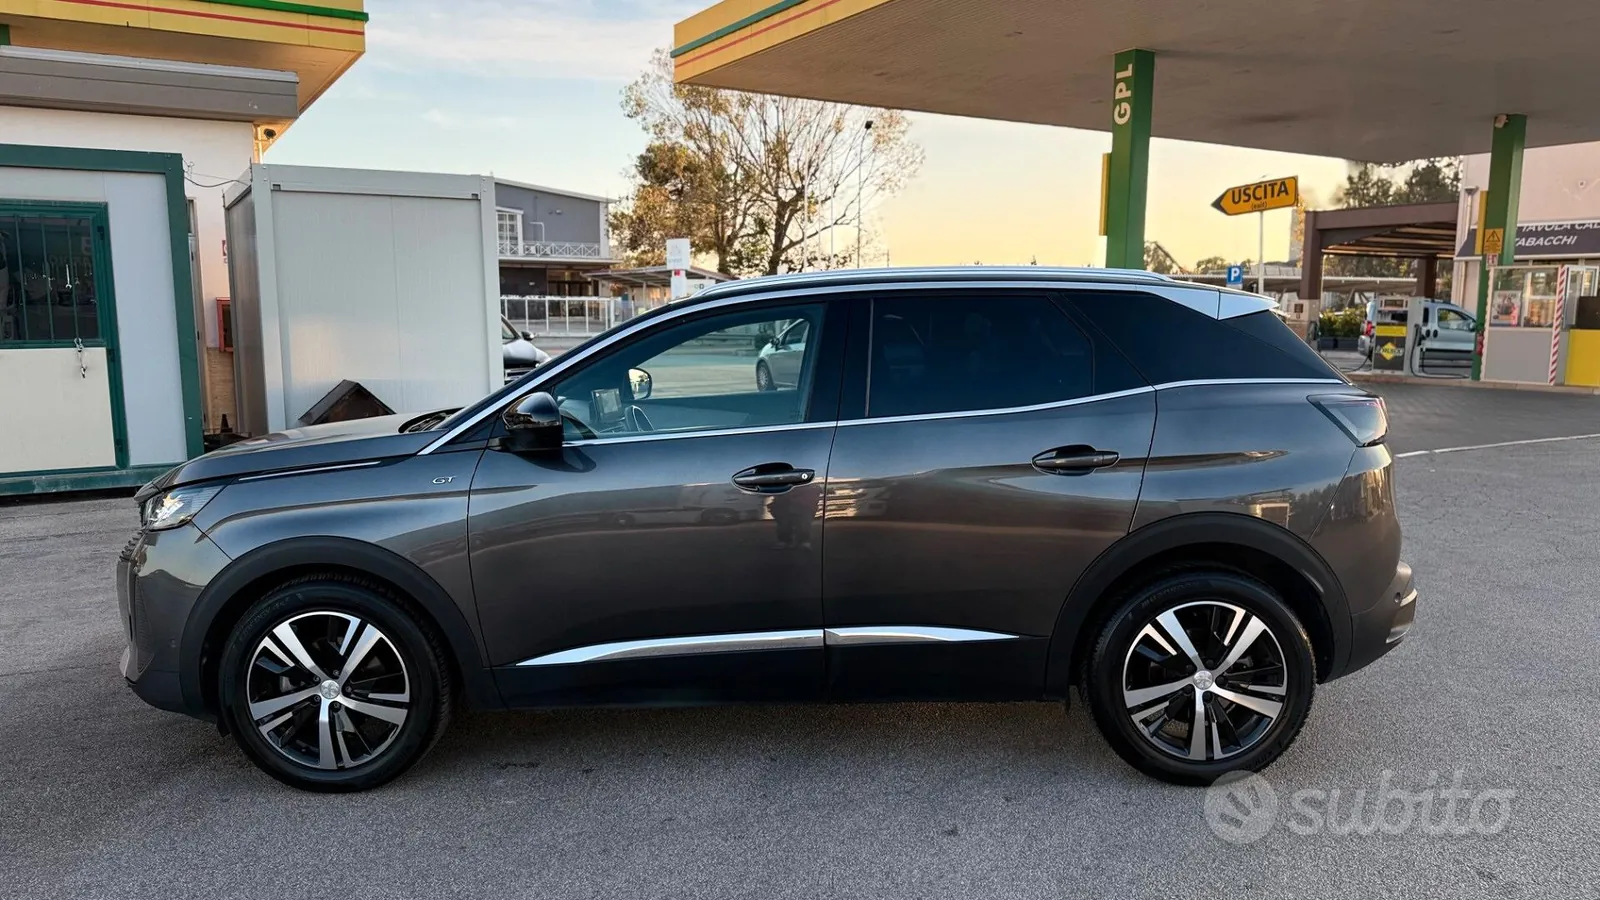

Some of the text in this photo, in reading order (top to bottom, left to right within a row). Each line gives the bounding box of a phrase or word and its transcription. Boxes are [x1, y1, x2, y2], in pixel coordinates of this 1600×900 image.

[1113, 63, 1133, 125] GPL
[1231, 180, 1289, 205] USCITA
[1230, 267, 1240, 281] P
[432, 475, 457, 484] GT
